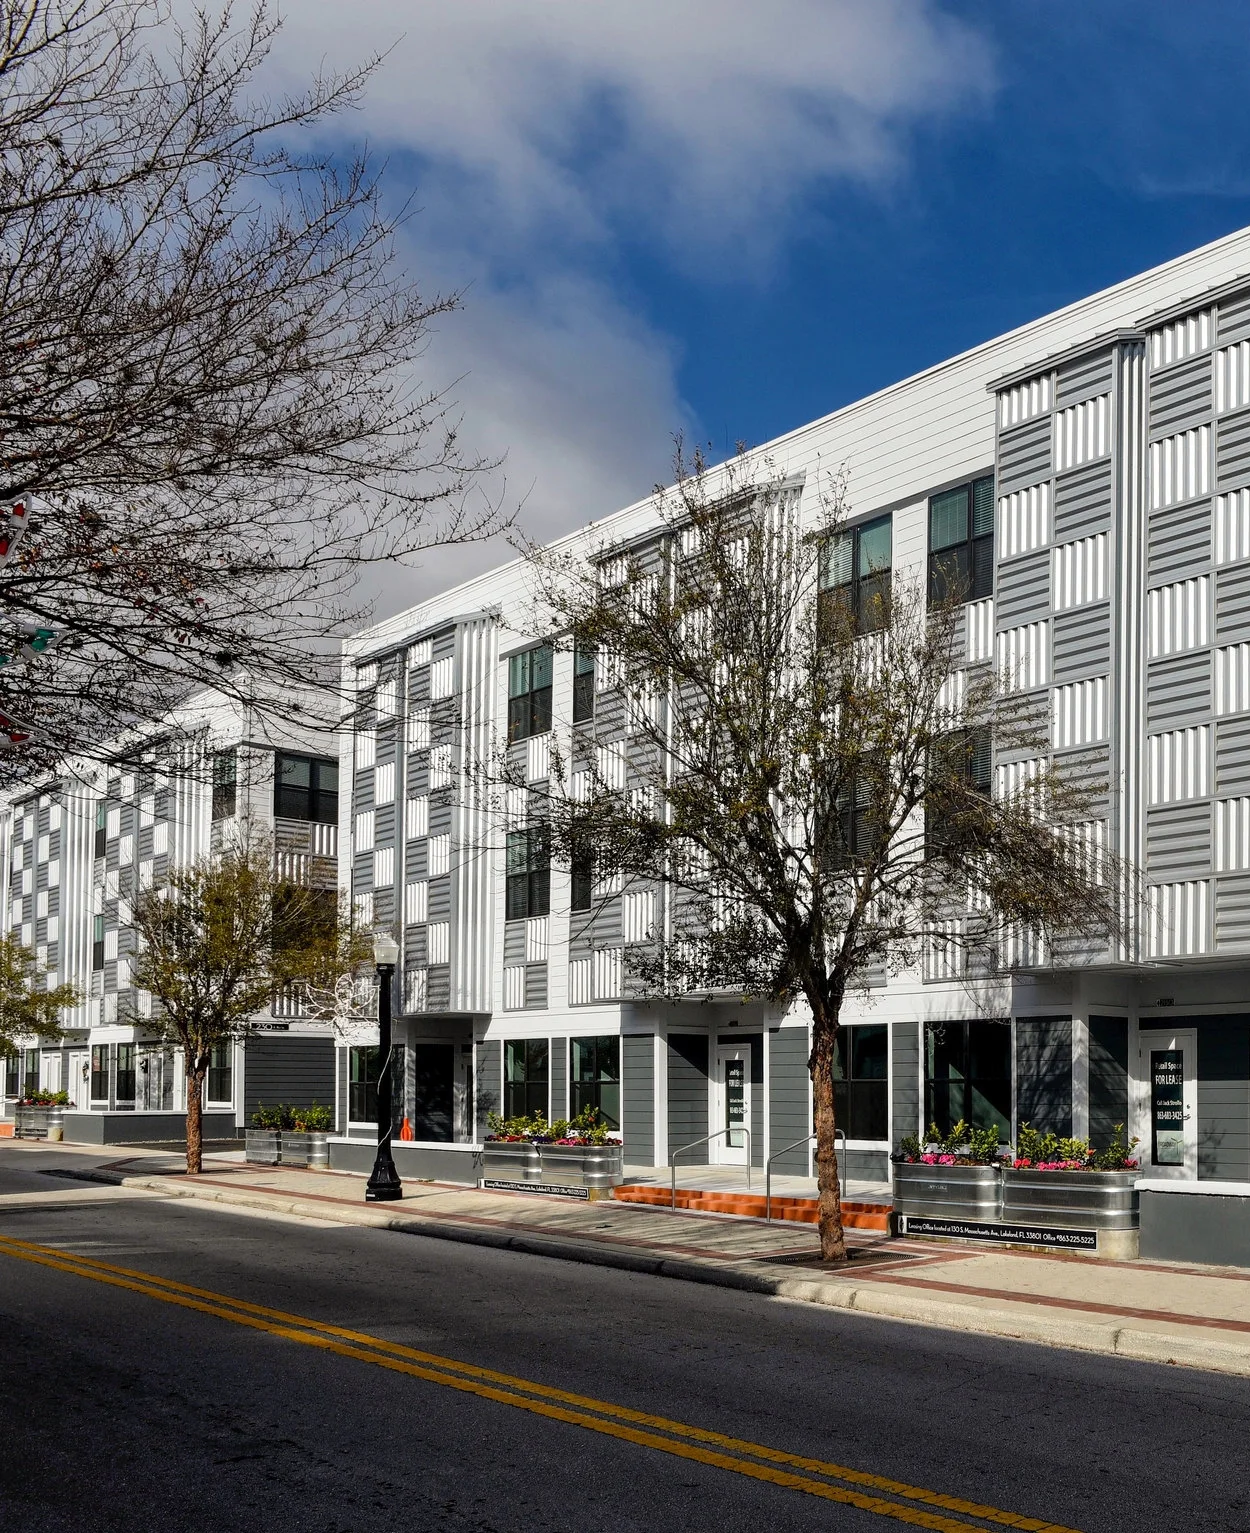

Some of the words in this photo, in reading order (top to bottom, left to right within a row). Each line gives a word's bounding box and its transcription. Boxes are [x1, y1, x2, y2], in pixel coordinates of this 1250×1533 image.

[1155, 1075, 1166, 1085] FOR
[1166, 1075, 1182, 1085] LEASE
[908, 1222, 923, 1231] Leasing
[922, 1223, 934, 1231] Office
[933, 1224, 947, 1232] located
[951, 1225, 960, 1233] 130
[1019, 1231, 1026, 1239] FL
[1026, 1232, 1042, 1240] 33801
[1042, 1233, 1056, 1241] Office
